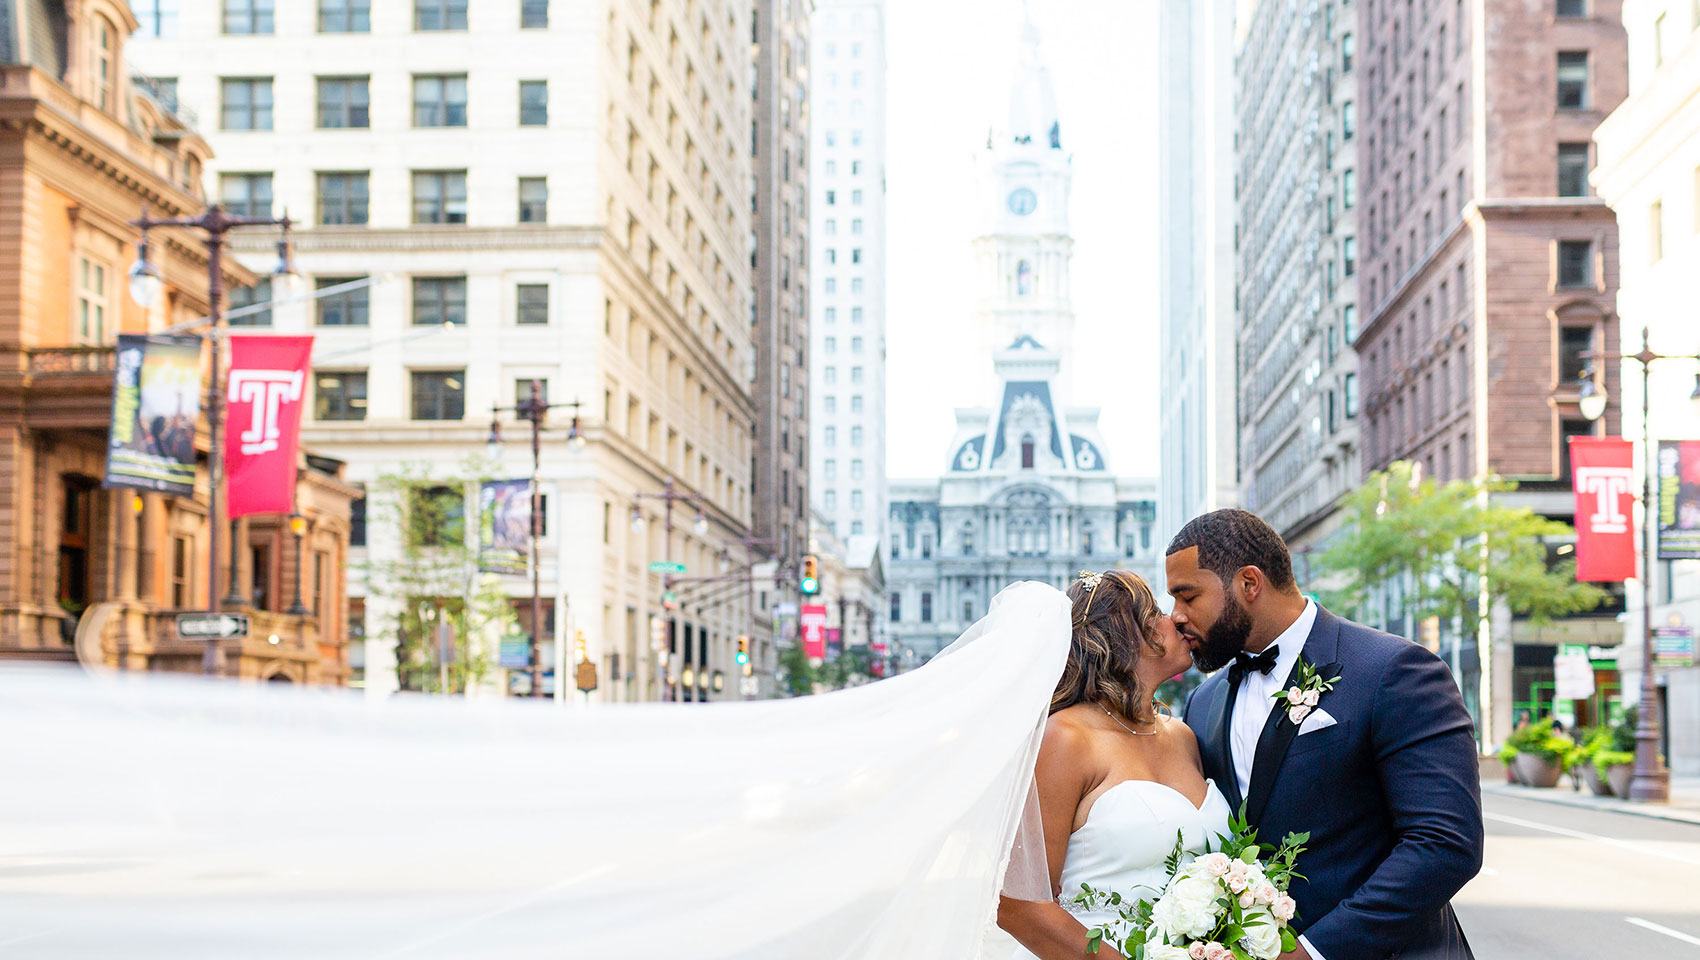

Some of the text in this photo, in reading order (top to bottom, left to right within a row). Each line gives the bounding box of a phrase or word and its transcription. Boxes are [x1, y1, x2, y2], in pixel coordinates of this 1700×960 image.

[228, 369, 303, 455] T
[1576, 466, 1633, 534] T
[801, 613, 826, 642] T
